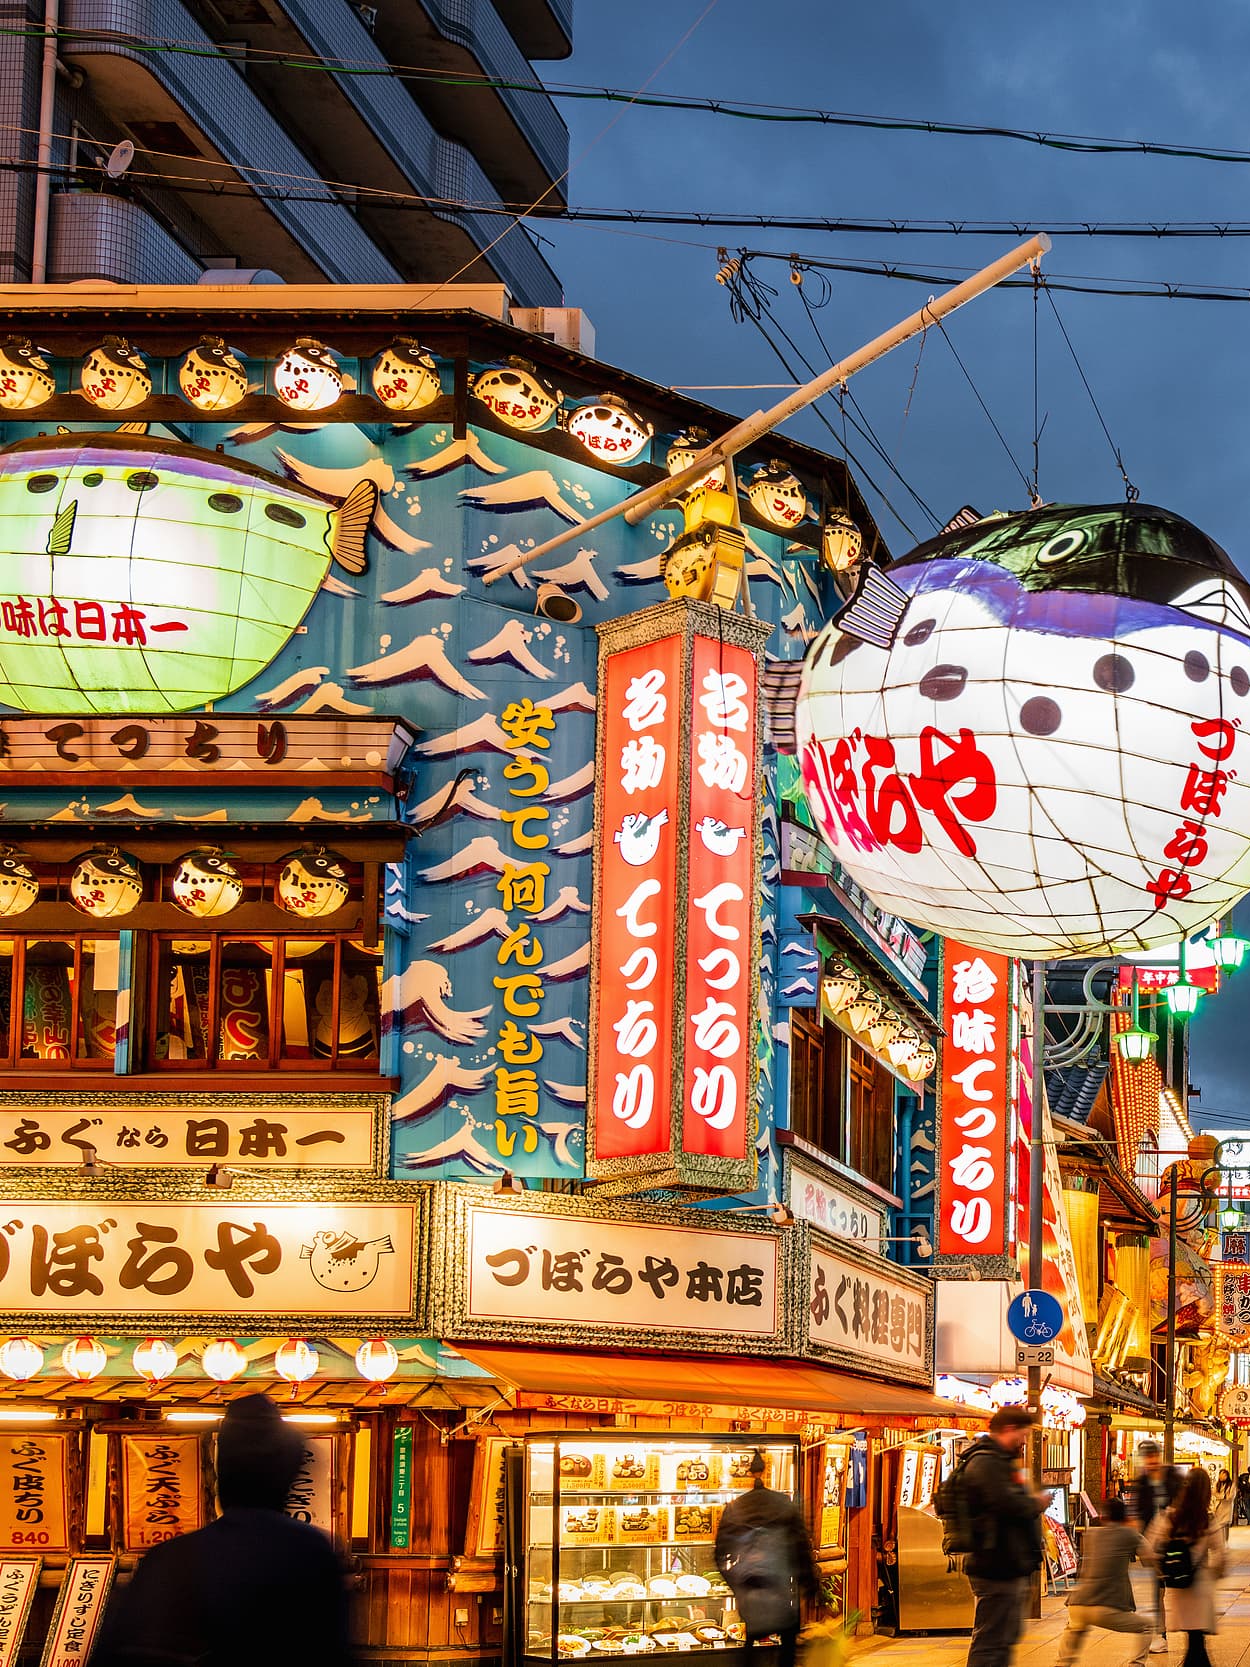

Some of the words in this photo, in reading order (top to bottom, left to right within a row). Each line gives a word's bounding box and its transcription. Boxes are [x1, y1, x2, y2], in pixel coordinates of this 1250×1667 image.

[0, 594, 189, 646] 味は日本一
[621, 668, 668, 795] 名物
[698, 668, 750, 795] 名物
[1146, 717, 1242, 910] づぼらや
[0, 1218, 281, 1298] ぼらや
[485, 1245, 764, 1307] づぼらや本店
[12, 1531, 49, 1544] 840
[397, 1503, 404, 1513] 5
[64, 1569, 100, 1653] にぎりずし定食
